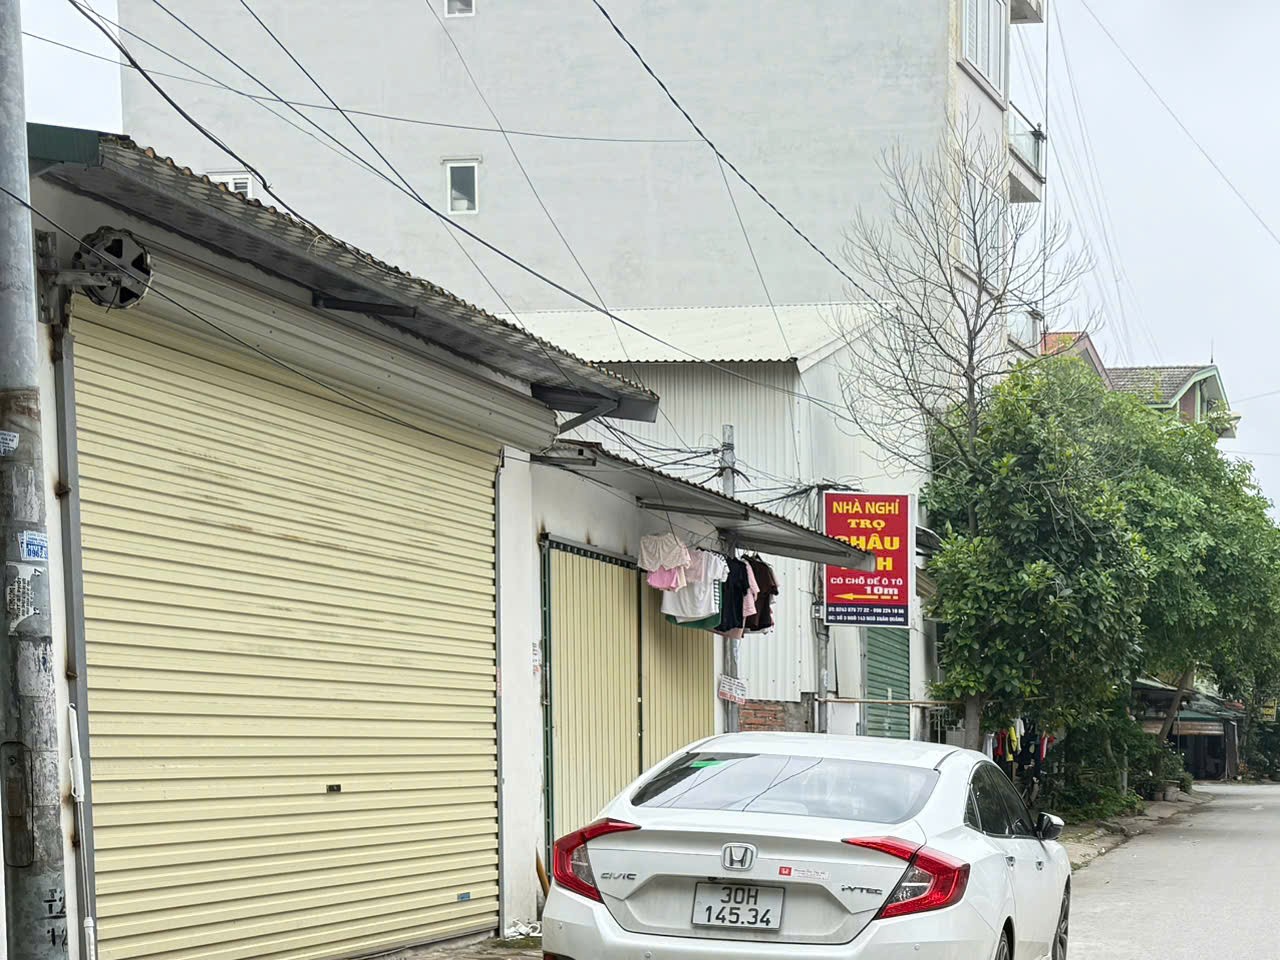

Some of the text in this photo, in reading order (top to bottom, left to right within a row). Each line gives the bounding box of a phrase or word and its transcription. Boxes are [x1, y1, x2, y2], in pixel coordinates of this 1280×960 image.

[833, 498, 900, 515] NHÀ NGHỈ
[847, 519, 885, 531] TRỌ
[864, 586, 899, 595] 10m
[600, 872, 637, 881] CIVIC
[720, 887, 759, 906] 30H
[705, 905, 771, 927] 145.34
